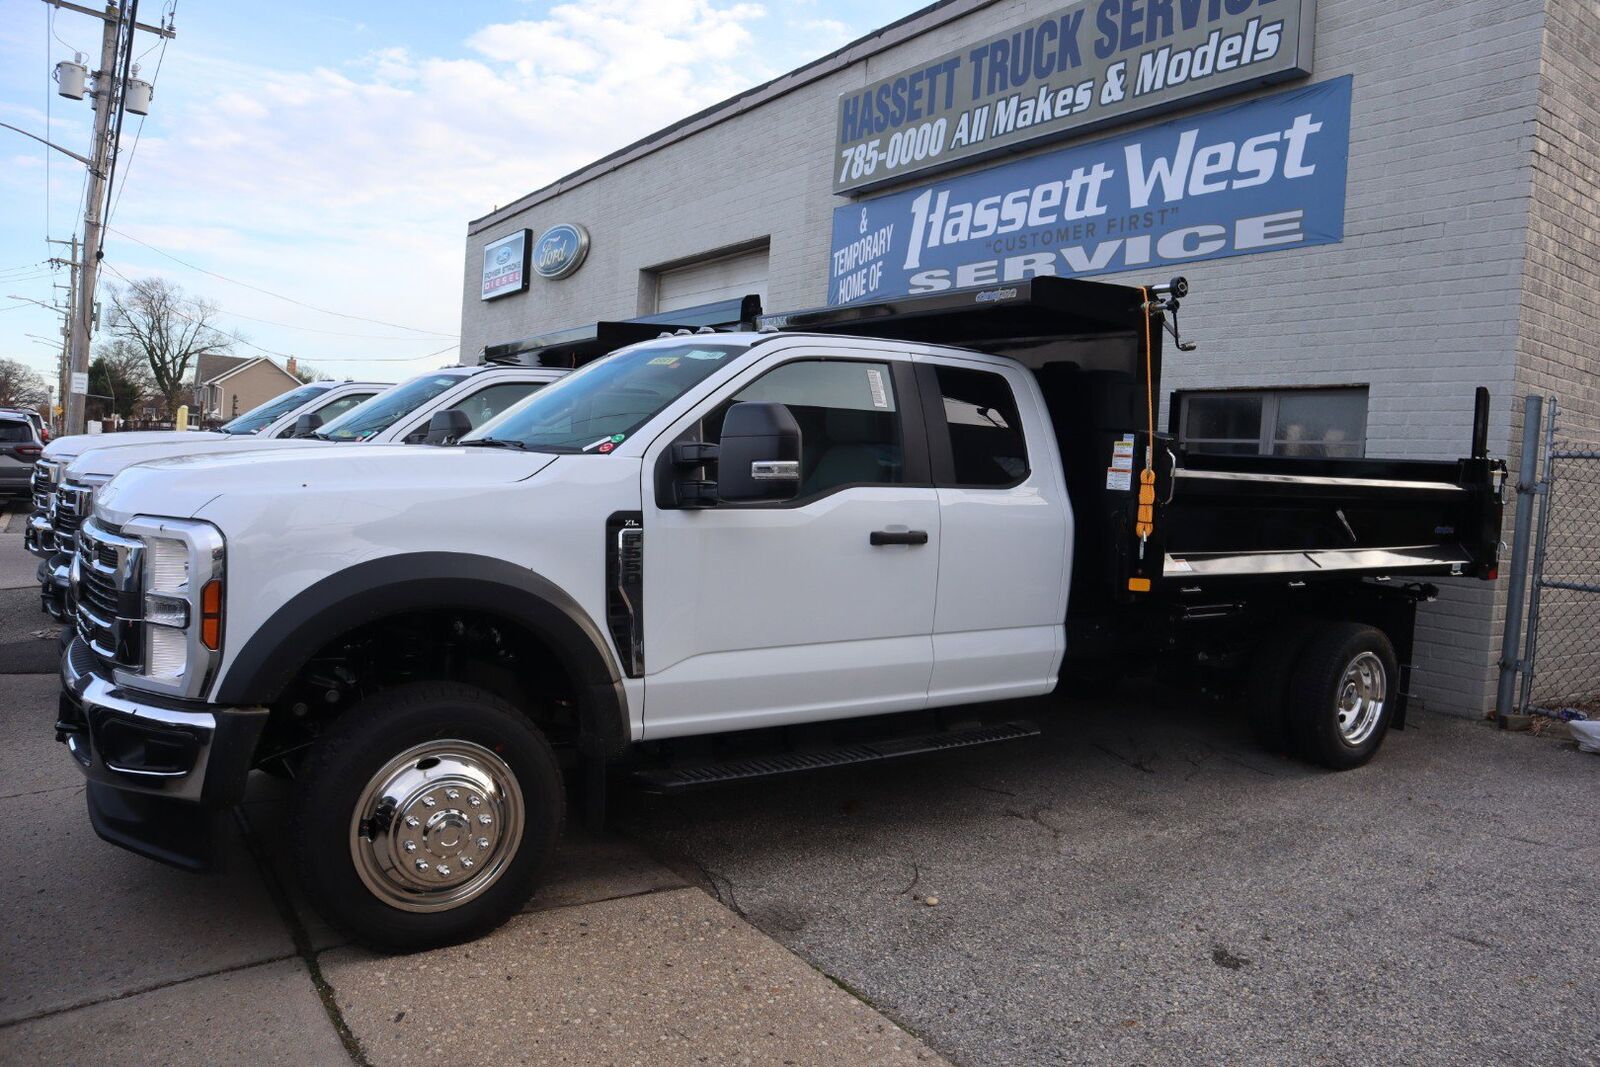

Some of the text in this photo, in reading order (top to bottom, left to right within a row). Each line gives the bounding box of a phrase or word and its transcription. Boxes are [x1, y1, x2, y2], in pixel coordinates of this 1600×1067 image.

[839, 17, 1284, 183] 785-0000 All Makes & Models
[842, 56, 961, 144] HASSETT
[969, 9, 1085, 101] TRUCK
[903, 113, 1323, 269] Hassett West
[859, 207, 868, 232] &
[540, 235, 567, 268] Ford
[834, 223, 894, 278] TEMPORARY
[909, 209, 1304, 294] SERVICE
[484, 271, 520, 290] DIESEL
[838, 261, 883, 305] HOME OF
